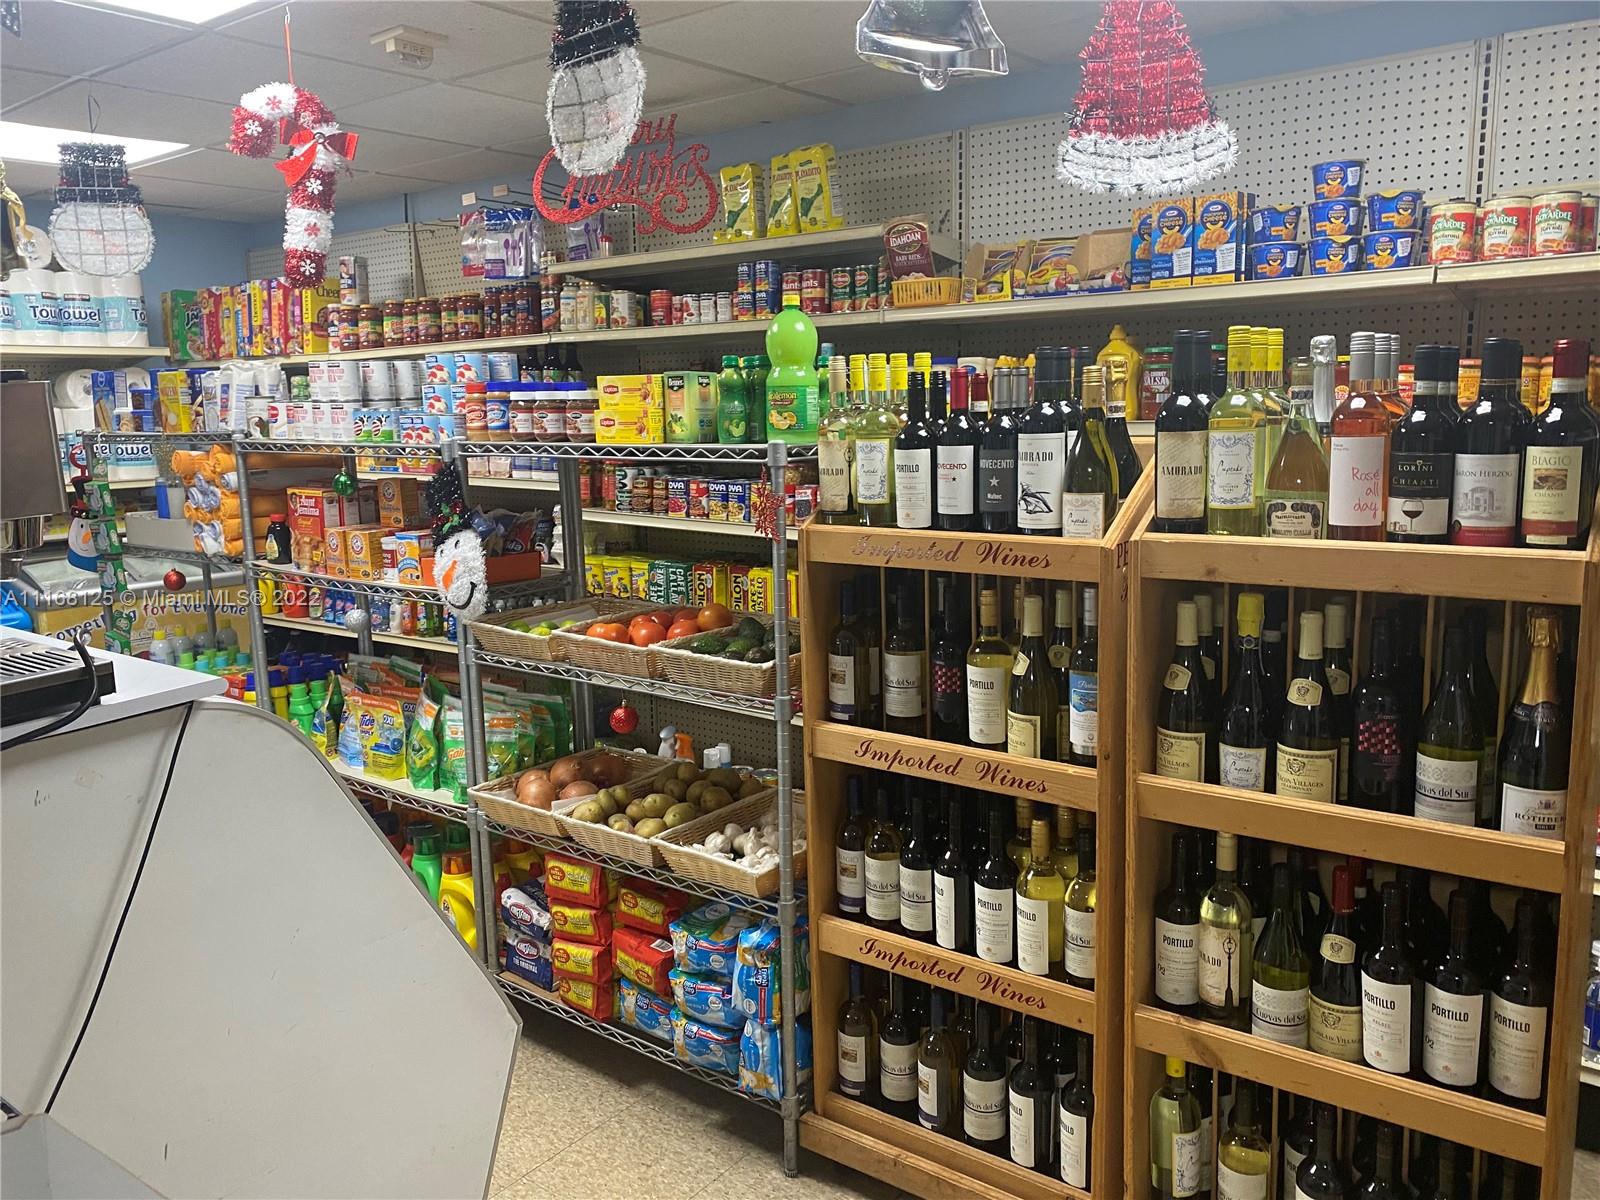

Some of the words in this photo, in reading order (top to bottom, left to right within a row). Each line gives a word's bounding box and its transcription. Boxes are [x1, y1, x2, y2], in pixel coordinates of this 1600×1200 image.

[890, 231, 922, 248] IDAHOAN
[1531, 455, 1572, 466] BIAGIO
[896, 463, 920, 474] PORTILLO
[1479, 469, 1513, 478] HERZOG
[709, 482, 727, 492] OYA
[1391, 475, 1440, 486] CHIANTI
[1364, 482, 1380, 497] all
[299, 494, 316, 507] Aunt
[294, 505, 321, 517] Jemima
[1352, 499, 1379, 520] day
[852, 535, 964, 565] Imported
[976, 541, 1053, 568] Wines
[756, 576, 764, 612] USTELO
[143, 603, 168, 616] for
[969, 678, 995, 690] PORTILLO
[360, 714, 376, 727] Tide
[854, 739, 964, 777] Imported
[974, 760, 1050, 794] Wines
[977, 897, 1003, 912] PORTILLO
[1162, 934, 1194, 949] PORTILLO
[859, 938, 965, 984] Imported
[976, 971, 1047, 1010] Wines
[637, 993, 650, 1002] Fresh
[637, 999, 649, 1010] Step
[1364, 989, 1396, 1011] PORTILLO
[1431, 1002, 1469, 1022] PORTILLO
[1493, 1010, 1531, 1033] PORTILLO
